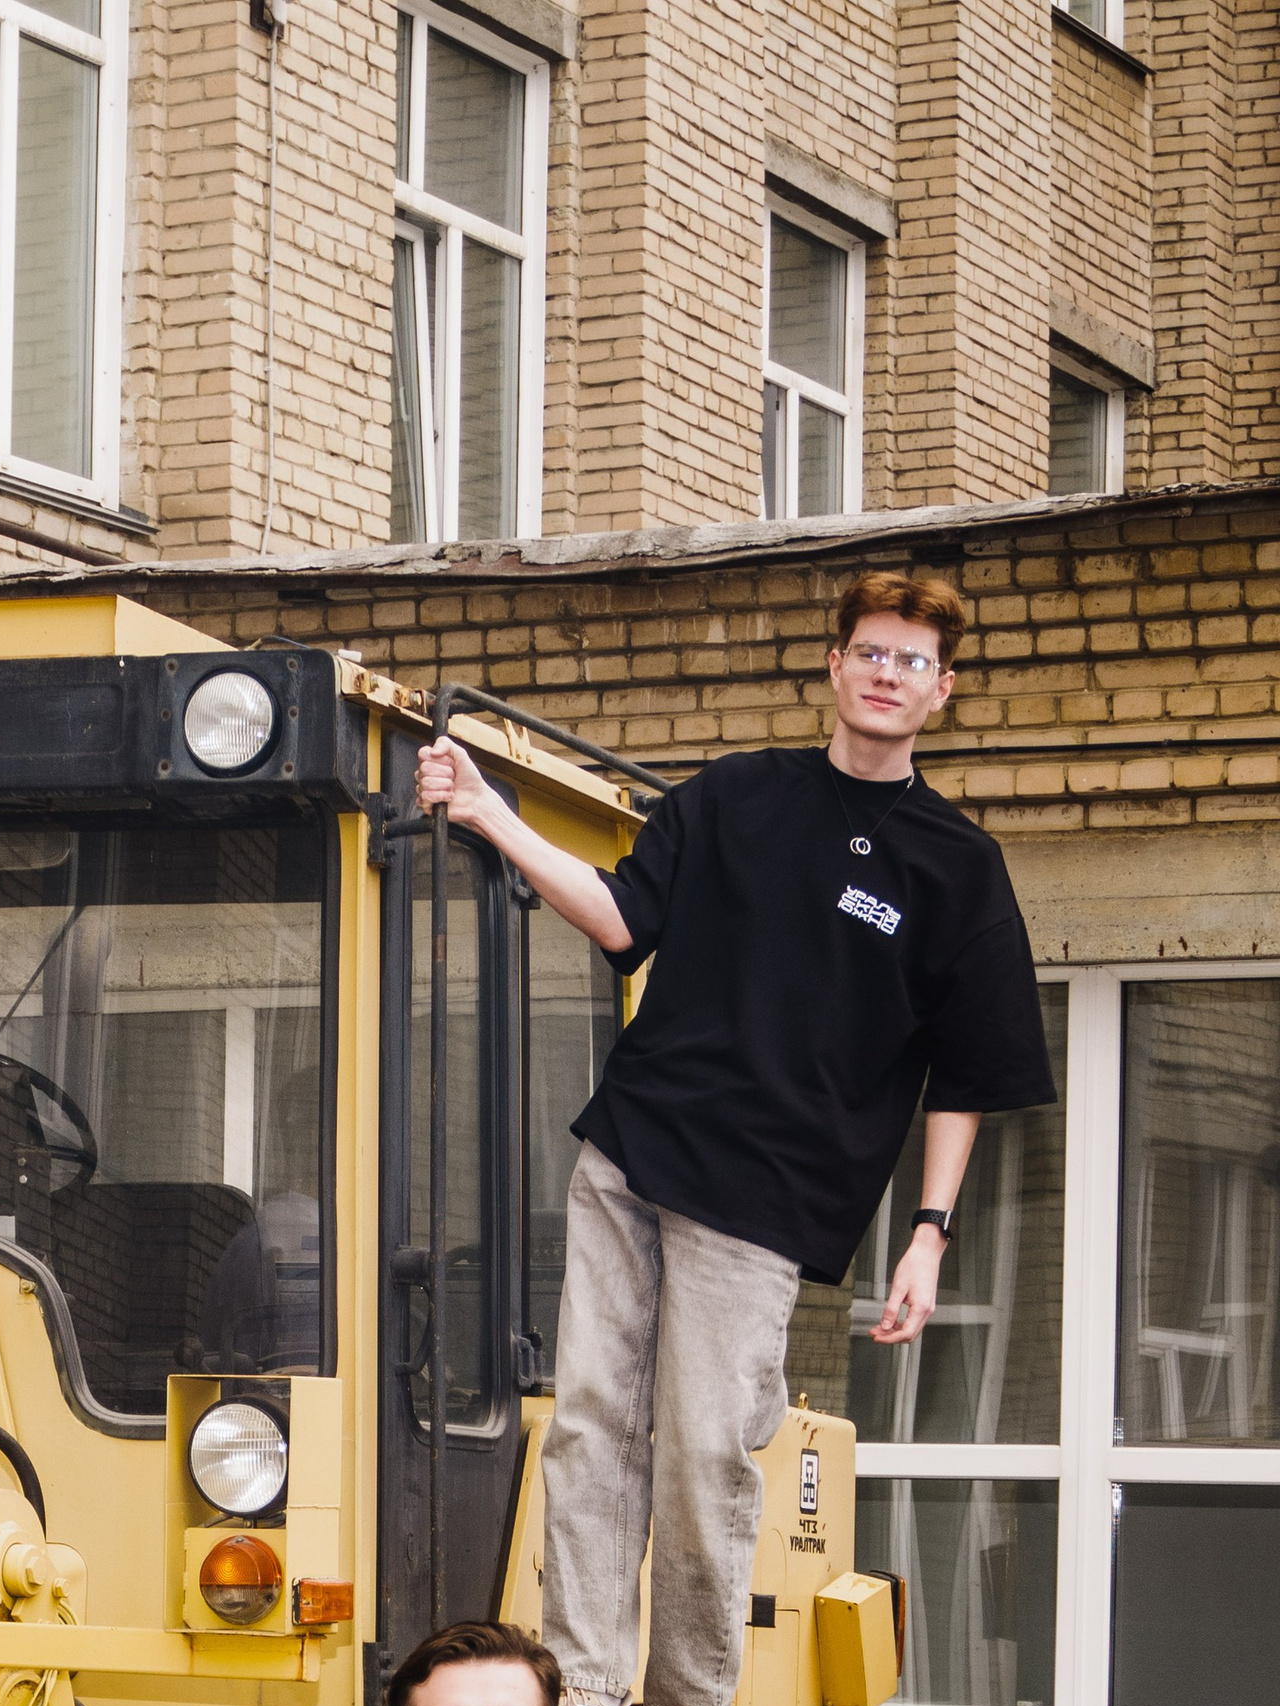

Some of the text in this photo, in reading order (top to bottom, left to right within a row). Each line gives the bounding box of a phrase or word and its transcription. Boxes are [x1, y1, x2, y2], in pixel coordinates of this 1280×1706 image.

[847, 885, 901, 921] УРАЛЬ
[837, 899, 894, 935] ЮЖНО
[799, 1519, 818, 1534] ЧТЗ
[789, 1535, 826, 1554] УРАЛТРАК
